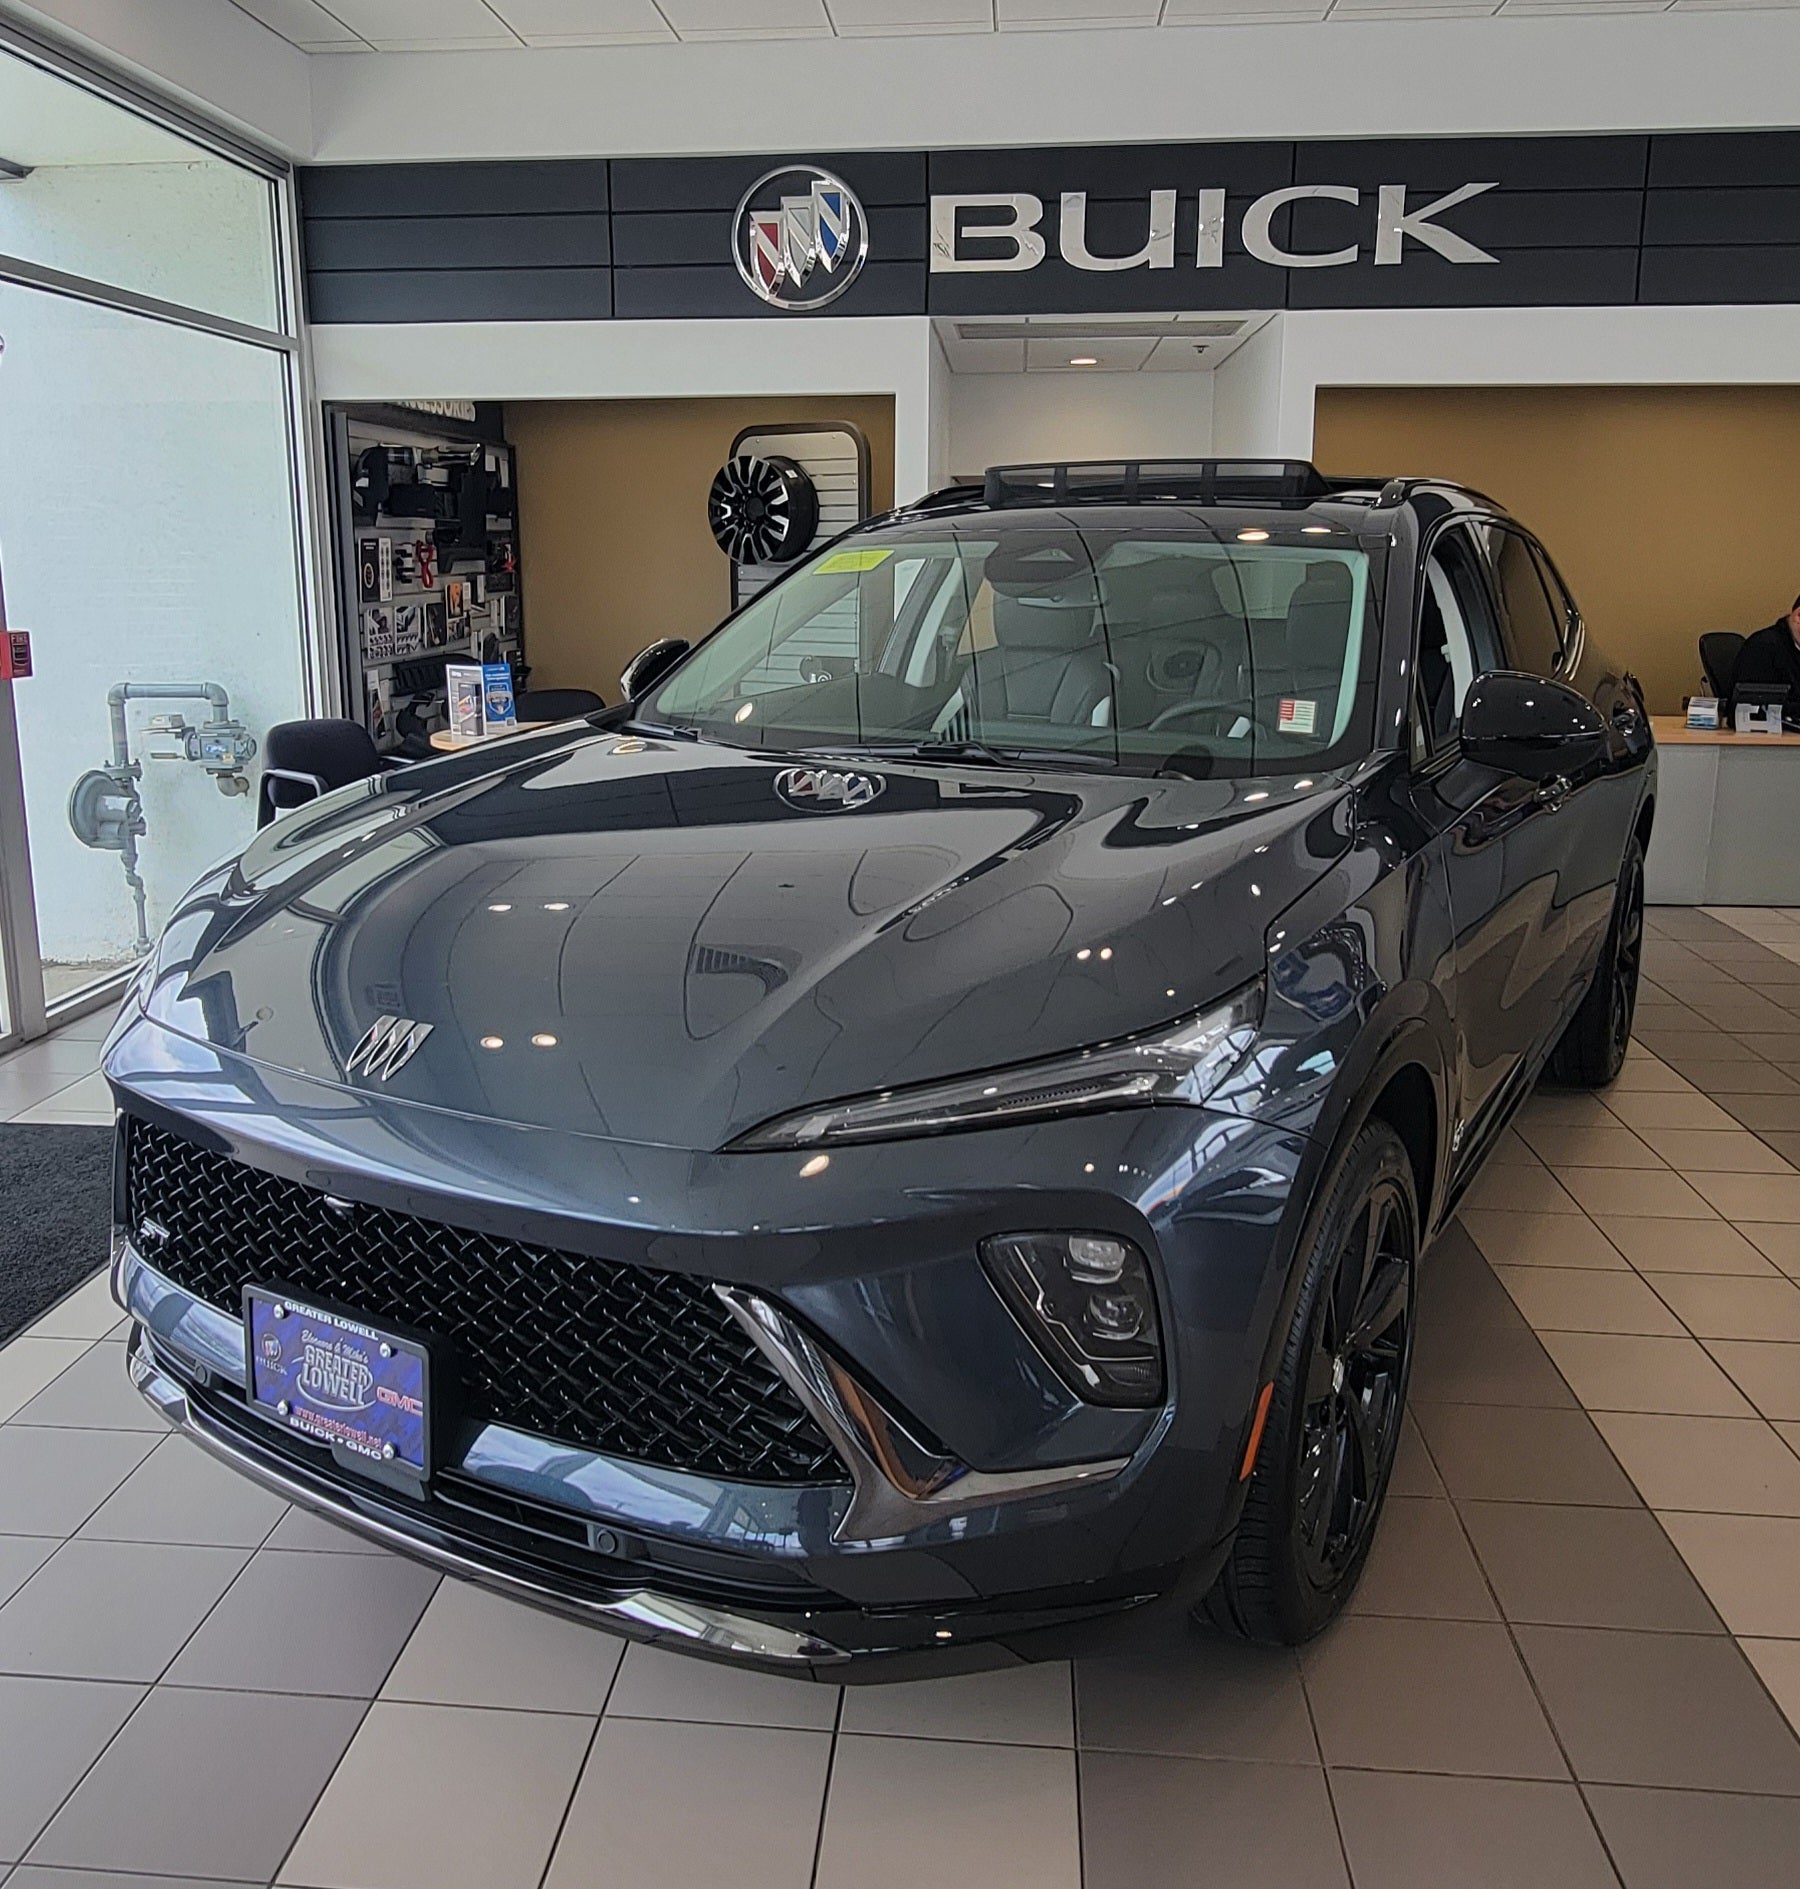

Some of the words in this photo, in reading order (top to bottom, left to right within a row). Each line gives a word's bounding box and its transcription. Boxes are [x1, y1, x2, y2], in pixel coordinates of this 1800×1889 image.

[930, 182, 1500, 273] BUICK
[284, 1301, 332, 1325] GREATER
[333, 1318, 379, 1342] LOWELL
[302, 1363, 365, 1406] LOWELL
[304, 1344, 369, 1387] GREATER
[376, 1386, 423, 1417] GMC
[289, 1417, 336, 1442] BUICK
[345, 1440, 383, 1461] GMC
